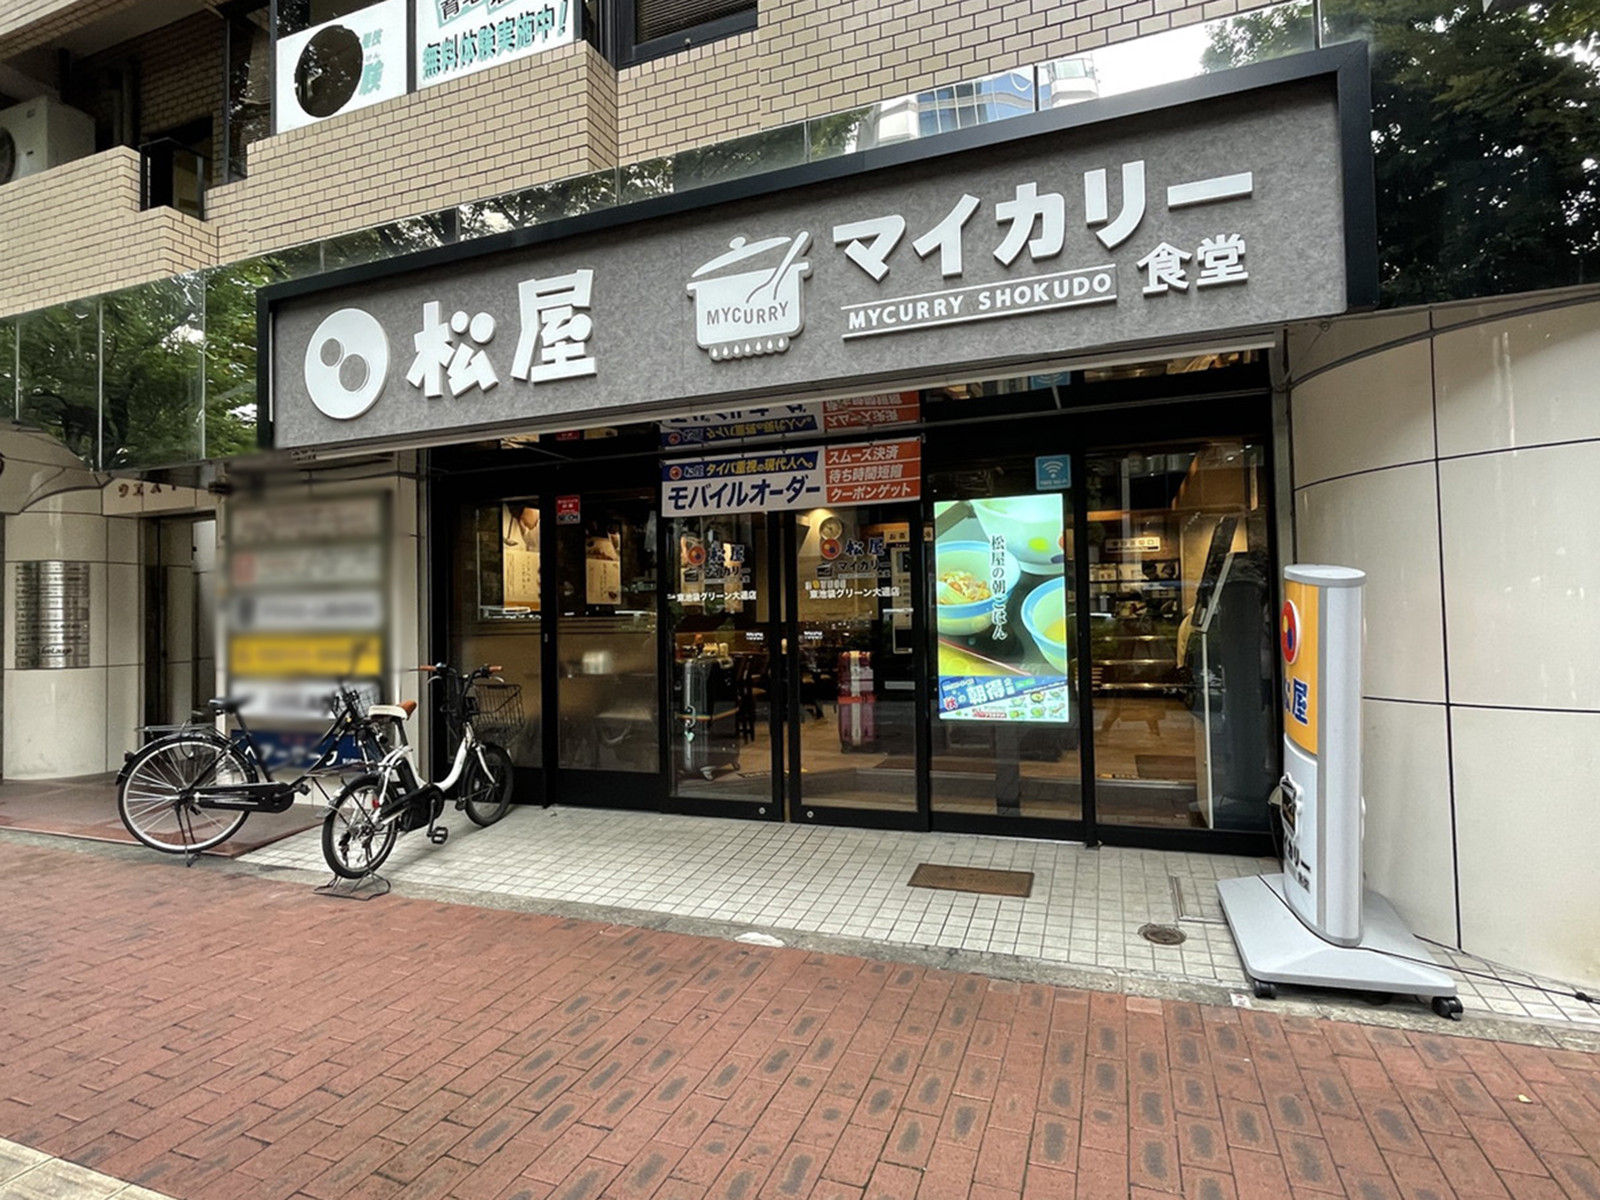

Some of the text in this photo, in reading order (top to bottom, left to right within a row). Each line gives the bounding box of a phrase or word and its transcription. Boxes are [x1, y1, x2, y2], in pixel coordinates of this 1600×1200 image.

[833, 160, 1253, 282] マイカリー
[1136, 233, 1249, 297] 食堂
[707, 301, 789, 326] MYCURRY
[848, 273, 1112, 330] MYCURRY SHOKUDO
[405, 269, 598, 399] 松屋
[828, 445, 899, 465] スムーズ決済
[829, 464, 904, 484] 待ち時間短縮
[668, 474, 821, 510] モバイルオーダー
[831, 482, 912, 502] クーポンゲット
[991, 535, 1008, 641] 松屋の朝ごはん
